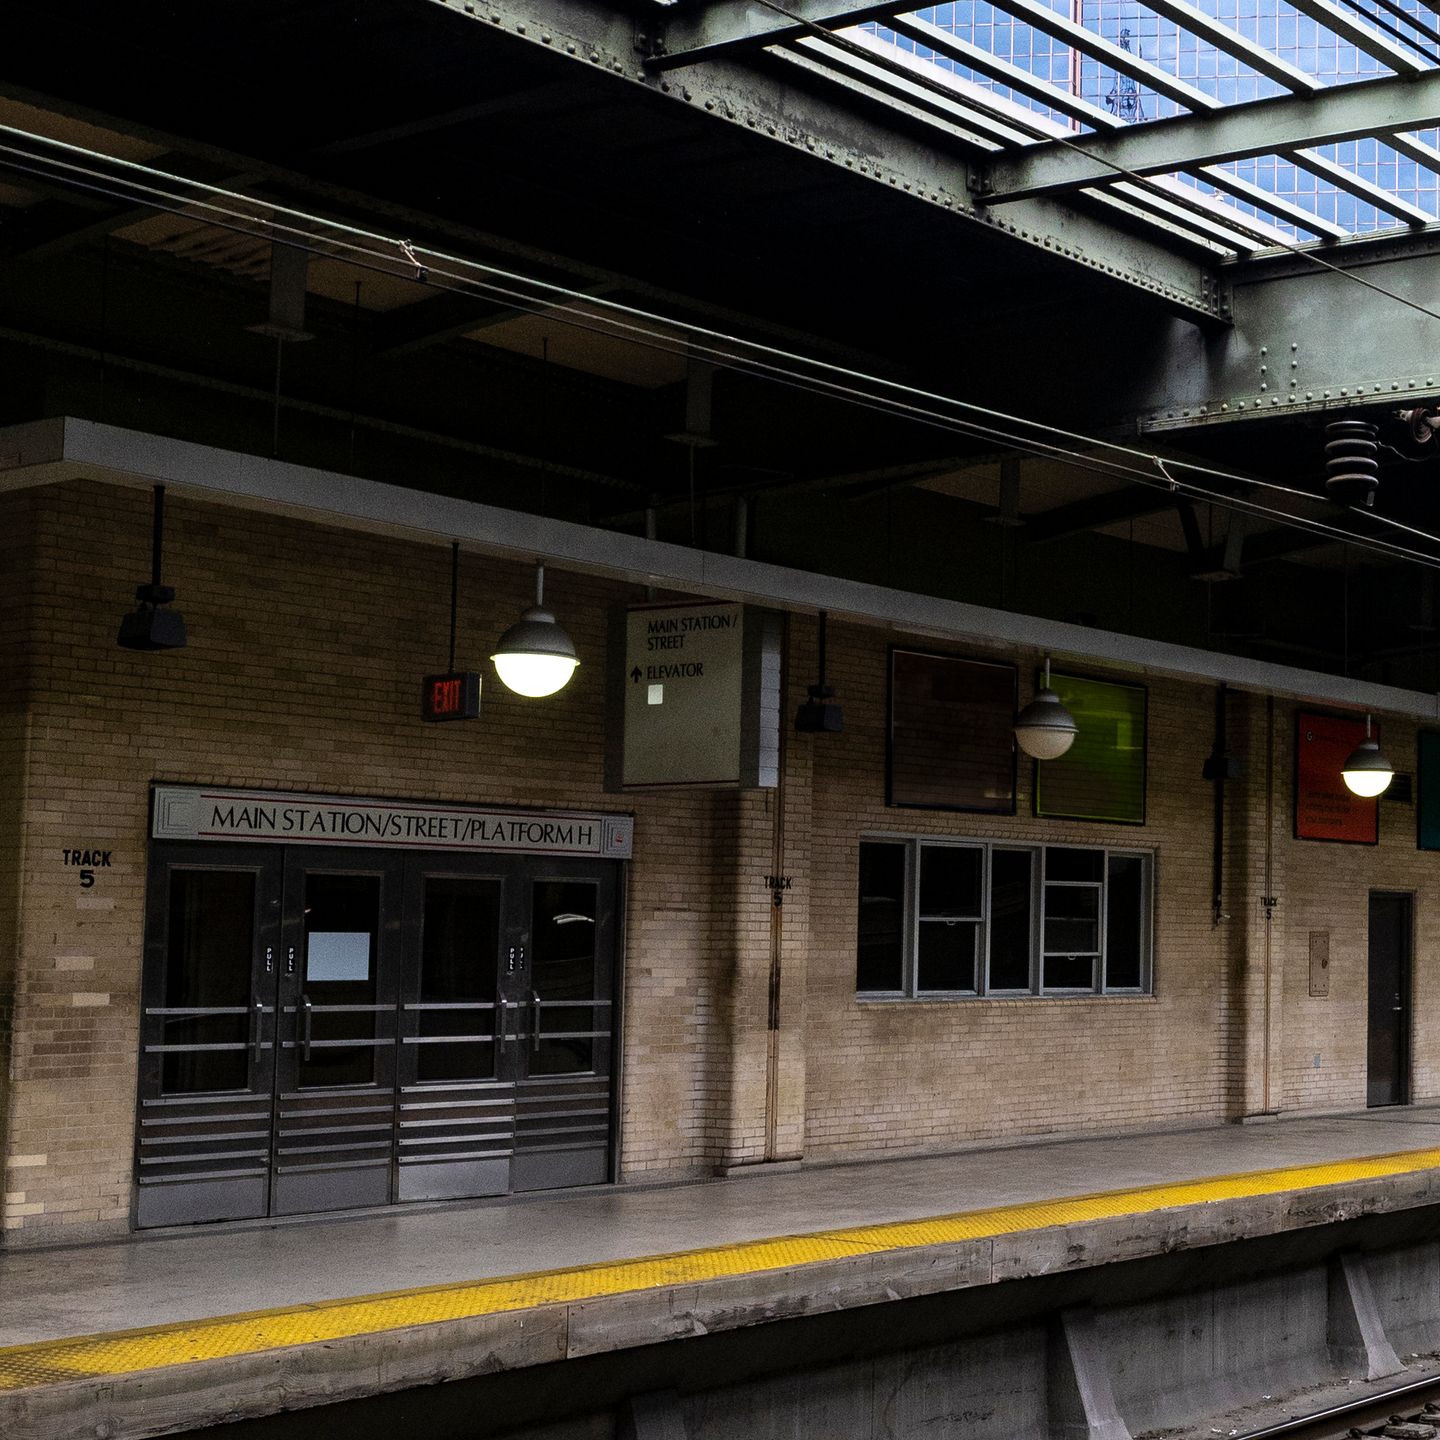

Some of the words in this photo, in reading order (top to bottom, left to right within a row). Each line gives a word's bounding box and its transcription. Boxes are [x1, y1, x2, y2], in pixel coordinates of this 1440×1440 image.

[648, 619, 678, 634] MAIN
[681, 615, 730, 631] STATION
[647, 634, 686, 651] STREET
[647, 662, 704, 680] ELEVATOR
[432, 679, 462, 715] EXIT
[212, 805, 276, 830] MAIN
[579, 825, 593, 845] H
[62, 850, 112, 867] TRACK
[80, 869, 95, 888] 5
[764, 875, 792, 890] TRACK
[774, 892, 783, 906] 5
[1260, 896, 1279, 907] TRACK
[1266, 908, 1272, 920] 5
